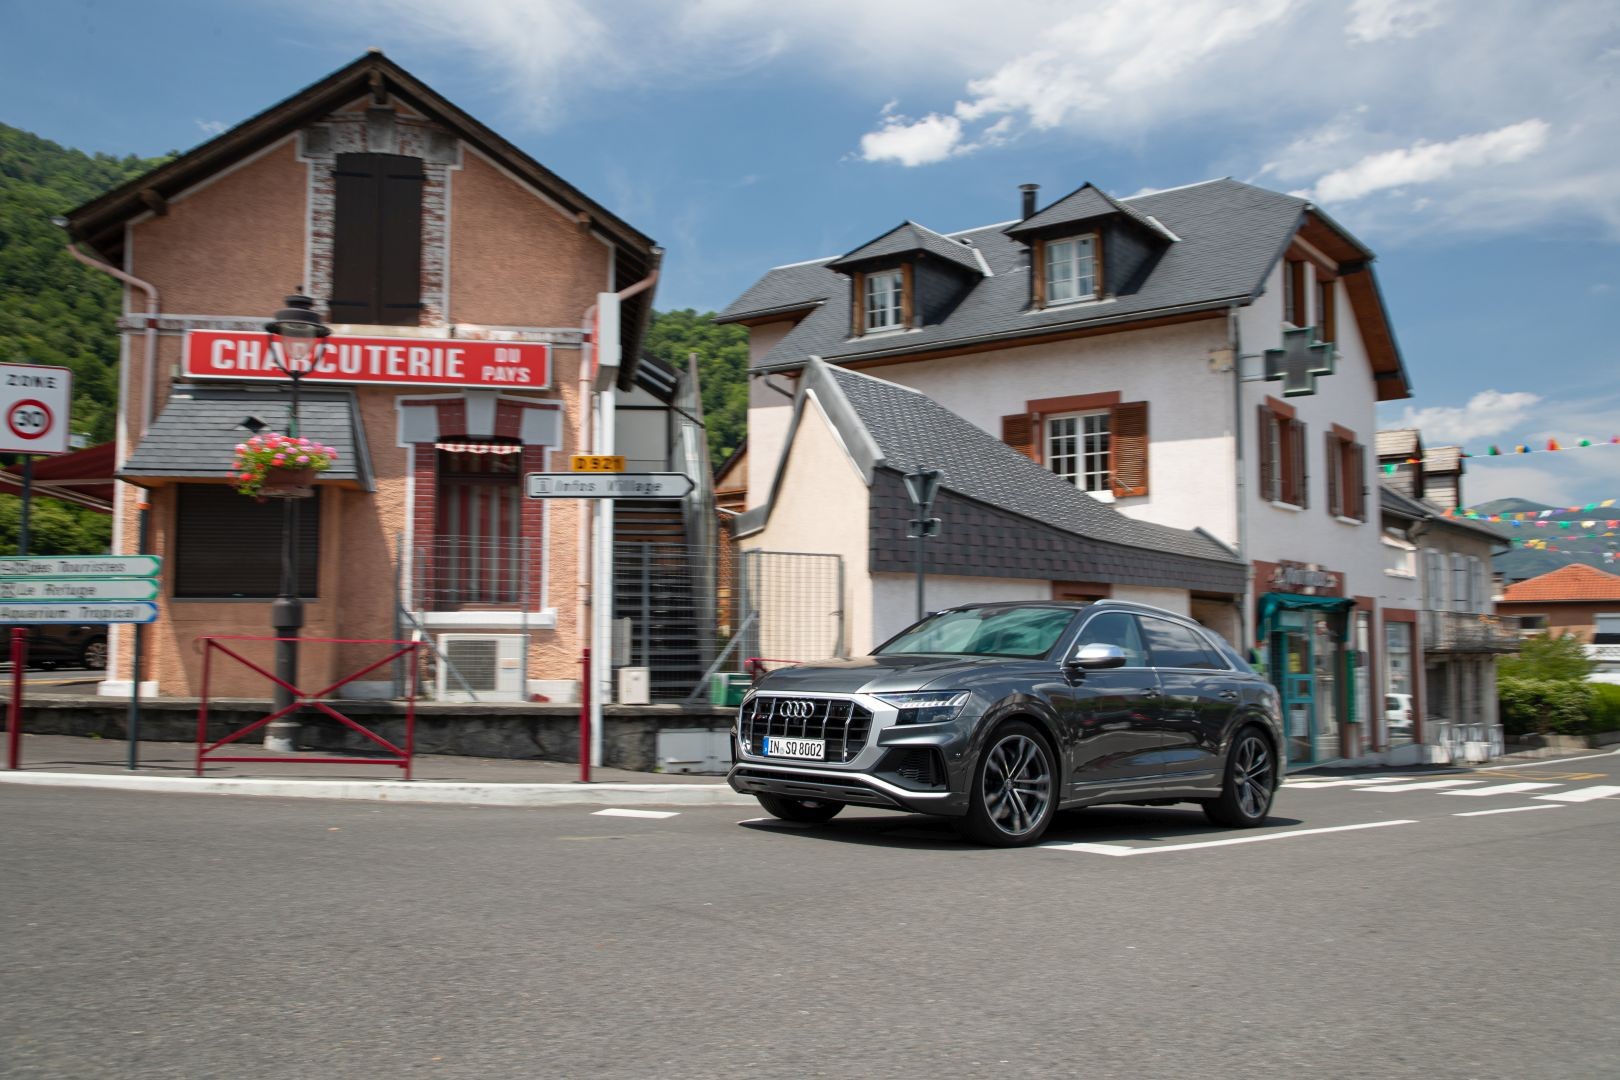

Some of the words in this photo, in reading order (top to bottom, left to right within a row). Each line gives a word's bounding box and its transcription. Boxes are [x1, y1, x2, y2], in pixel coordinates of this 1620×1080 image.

[210, 339, 466, 378] CHARCUTERIE
[494, 348, 520, 363] DU
[6, 374, 57, 389] ZONE
[481, 366, 531, 383] PAYS
[15, 410, 46, 427] 30
[577, 457, 586, 470] D
[591, 457, 622, 470] 921
[555, 479, 596, 492] Infos
[607, 479, 662, 494] Village
[59, 560, 126, 573] Touristes
[45, 583, 96, 599] Refuge
[0, 606, 69, 620] Aquarium
[79, 605, 140, 620] Tropical
[769, 740, 780, 754] IN
[785, 741, 798, 755] SQ
[799, 742, 822, 757] 8002
